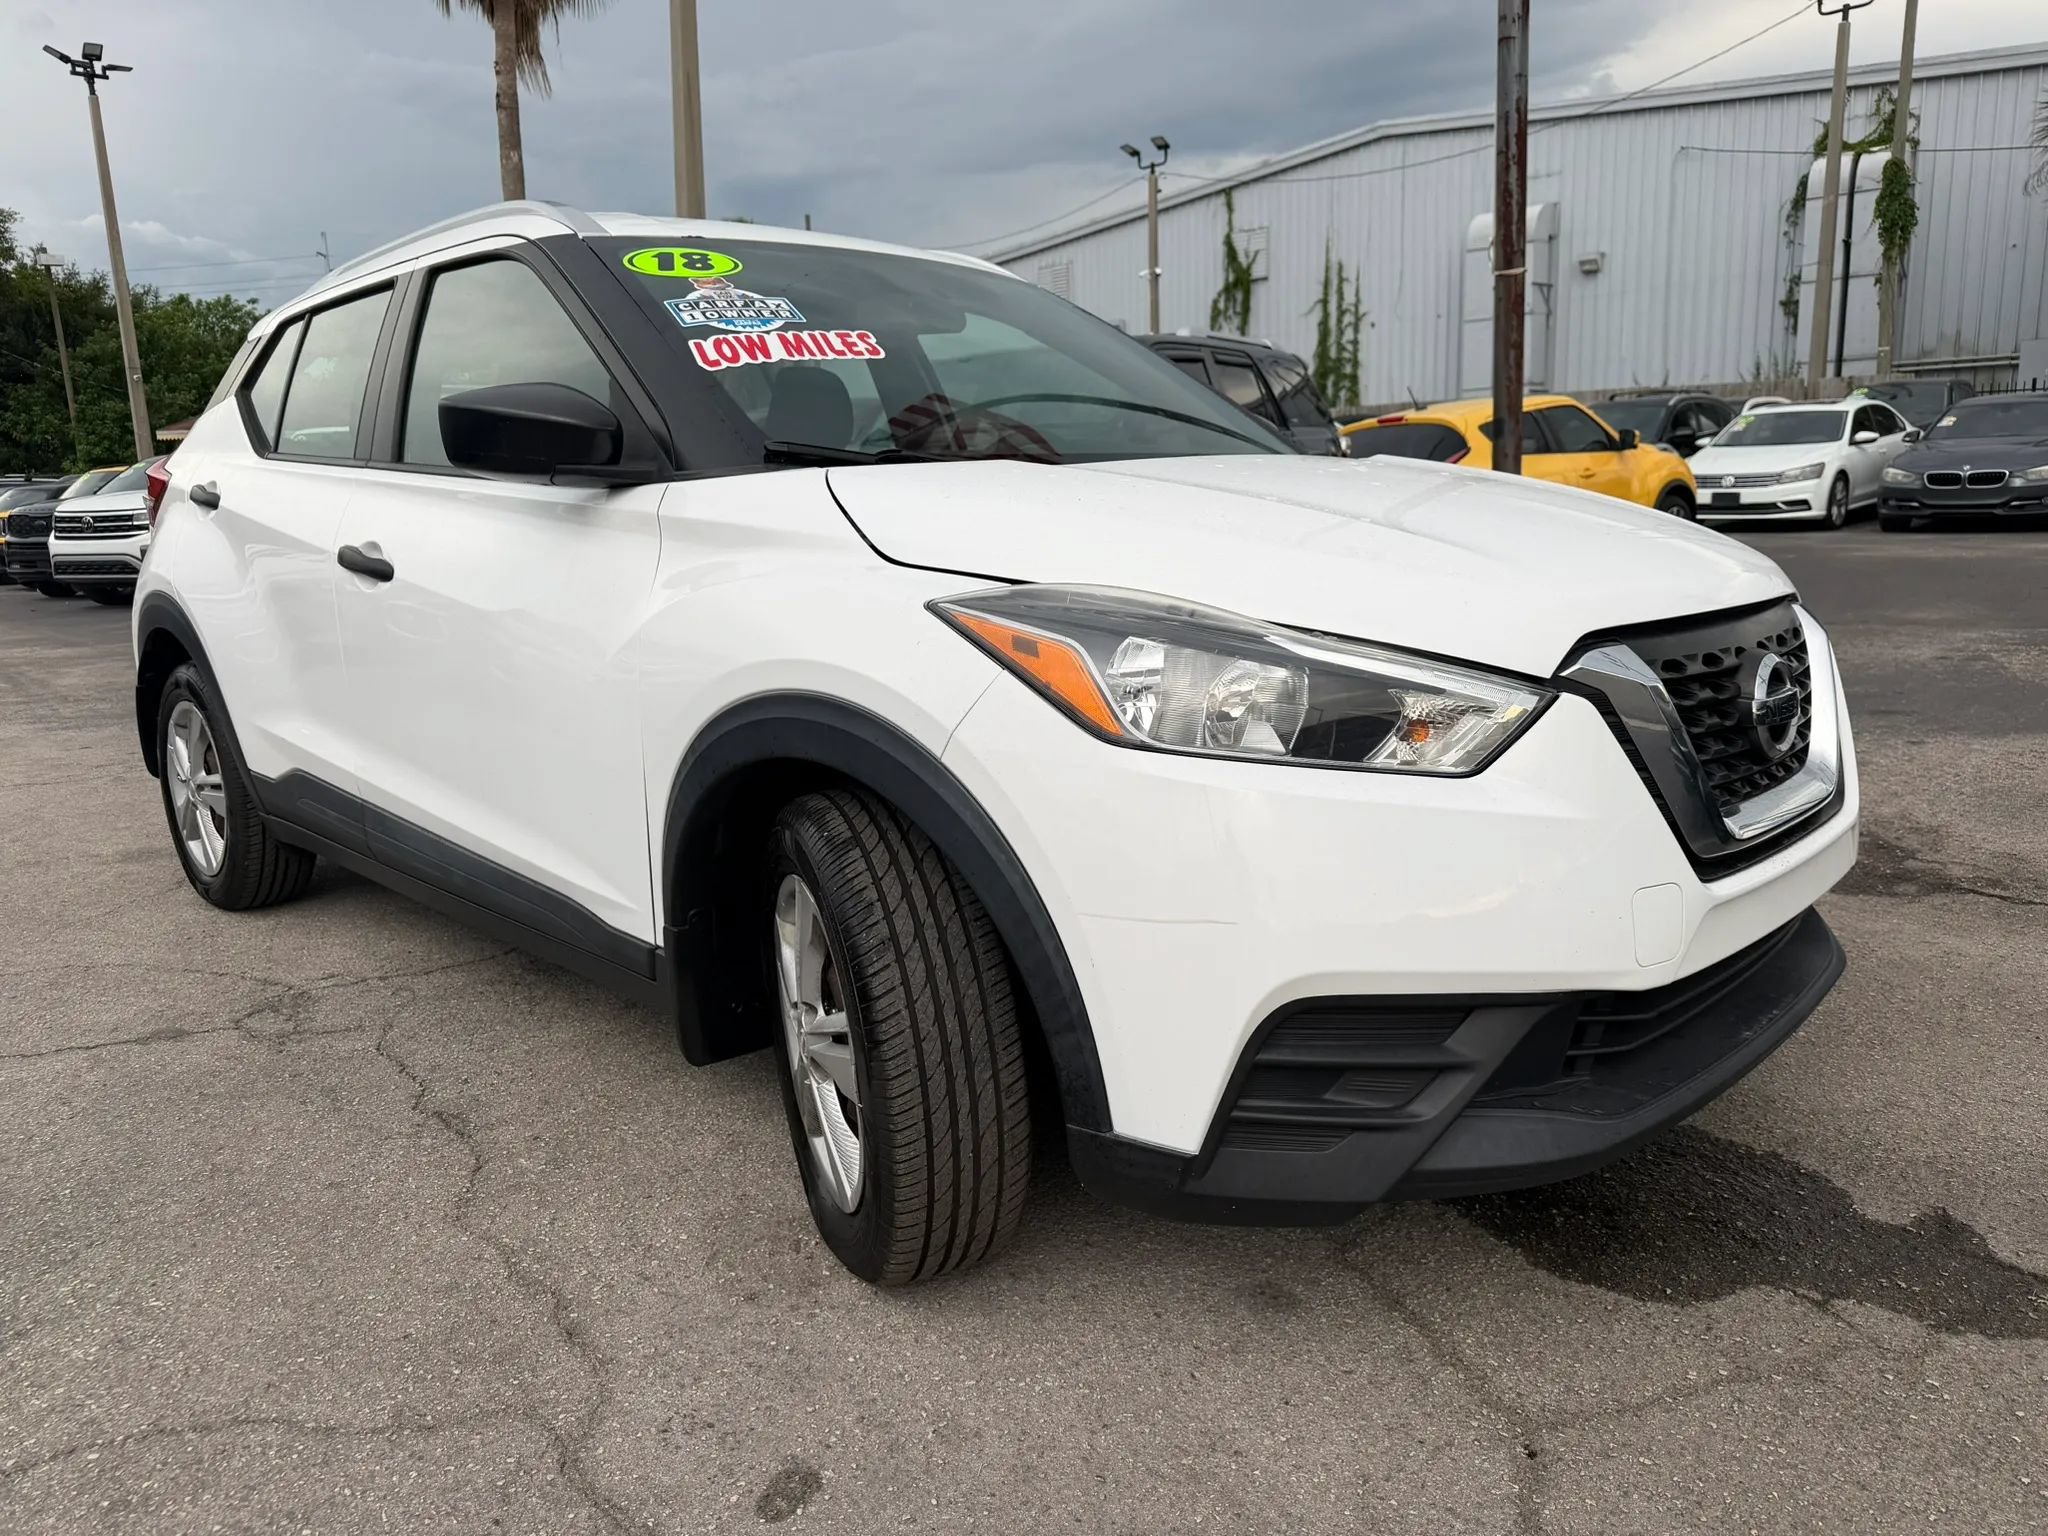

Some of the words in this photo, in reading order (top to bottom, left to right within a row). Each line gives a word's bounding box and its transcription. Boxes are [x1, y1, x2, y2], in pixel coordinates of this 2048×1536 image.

[652, 251, 716, 272] 18
[678, 300, 789, 311] CARFAX
[704, 310, 794, 320] OWNER
[693, 333, 768, 368] LOW
[776, 331, 882, 358] MILES
